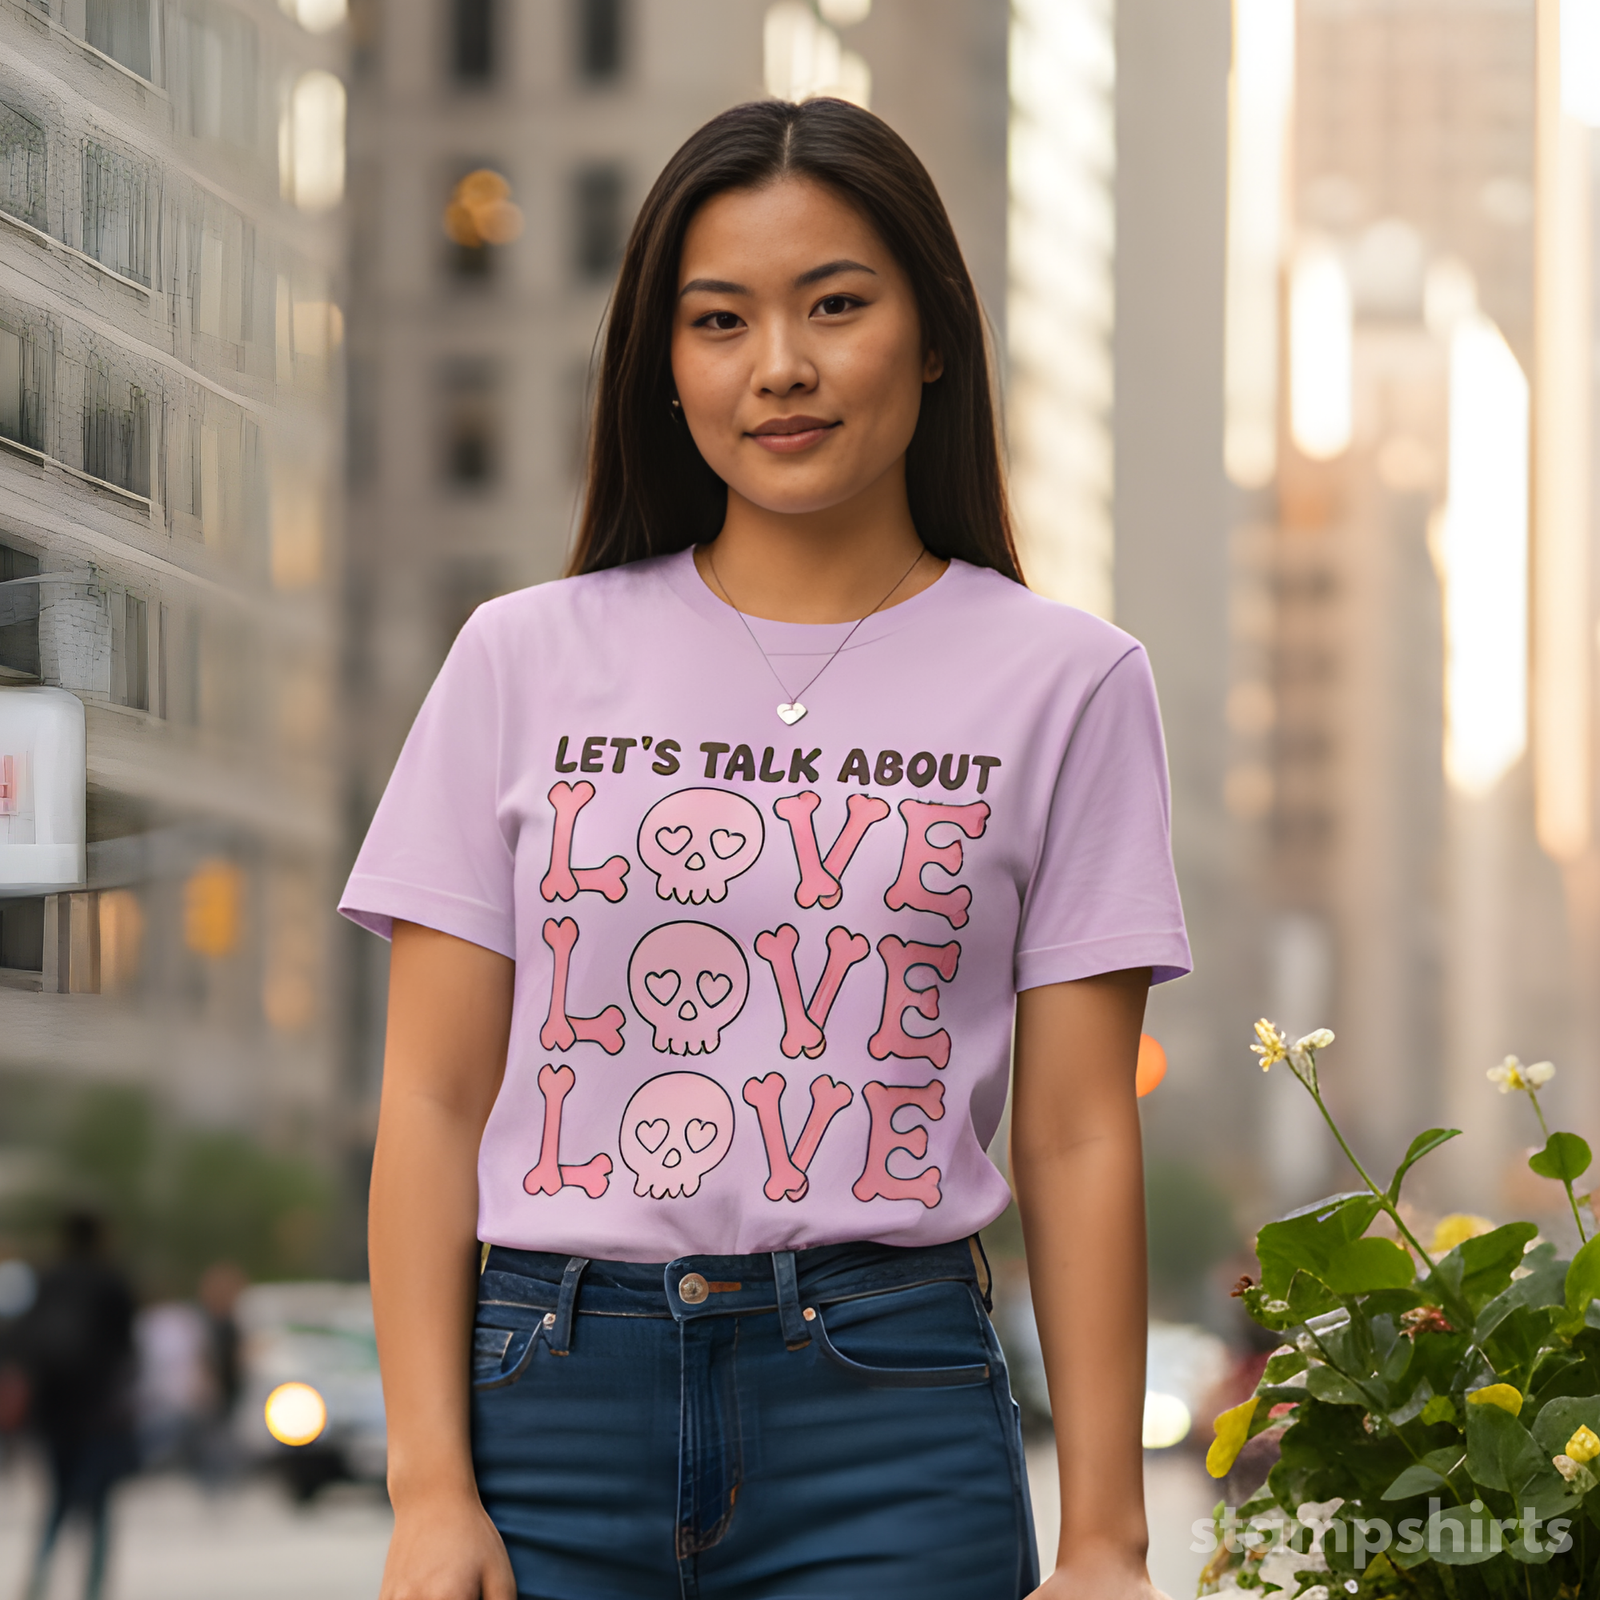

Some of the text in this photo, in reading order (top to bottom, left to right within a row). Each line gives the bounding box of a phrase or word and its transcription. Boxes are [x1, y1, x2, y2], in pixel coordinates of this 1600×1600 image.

[554, 735, 1002, 794] LET'S TALK ABOUT
